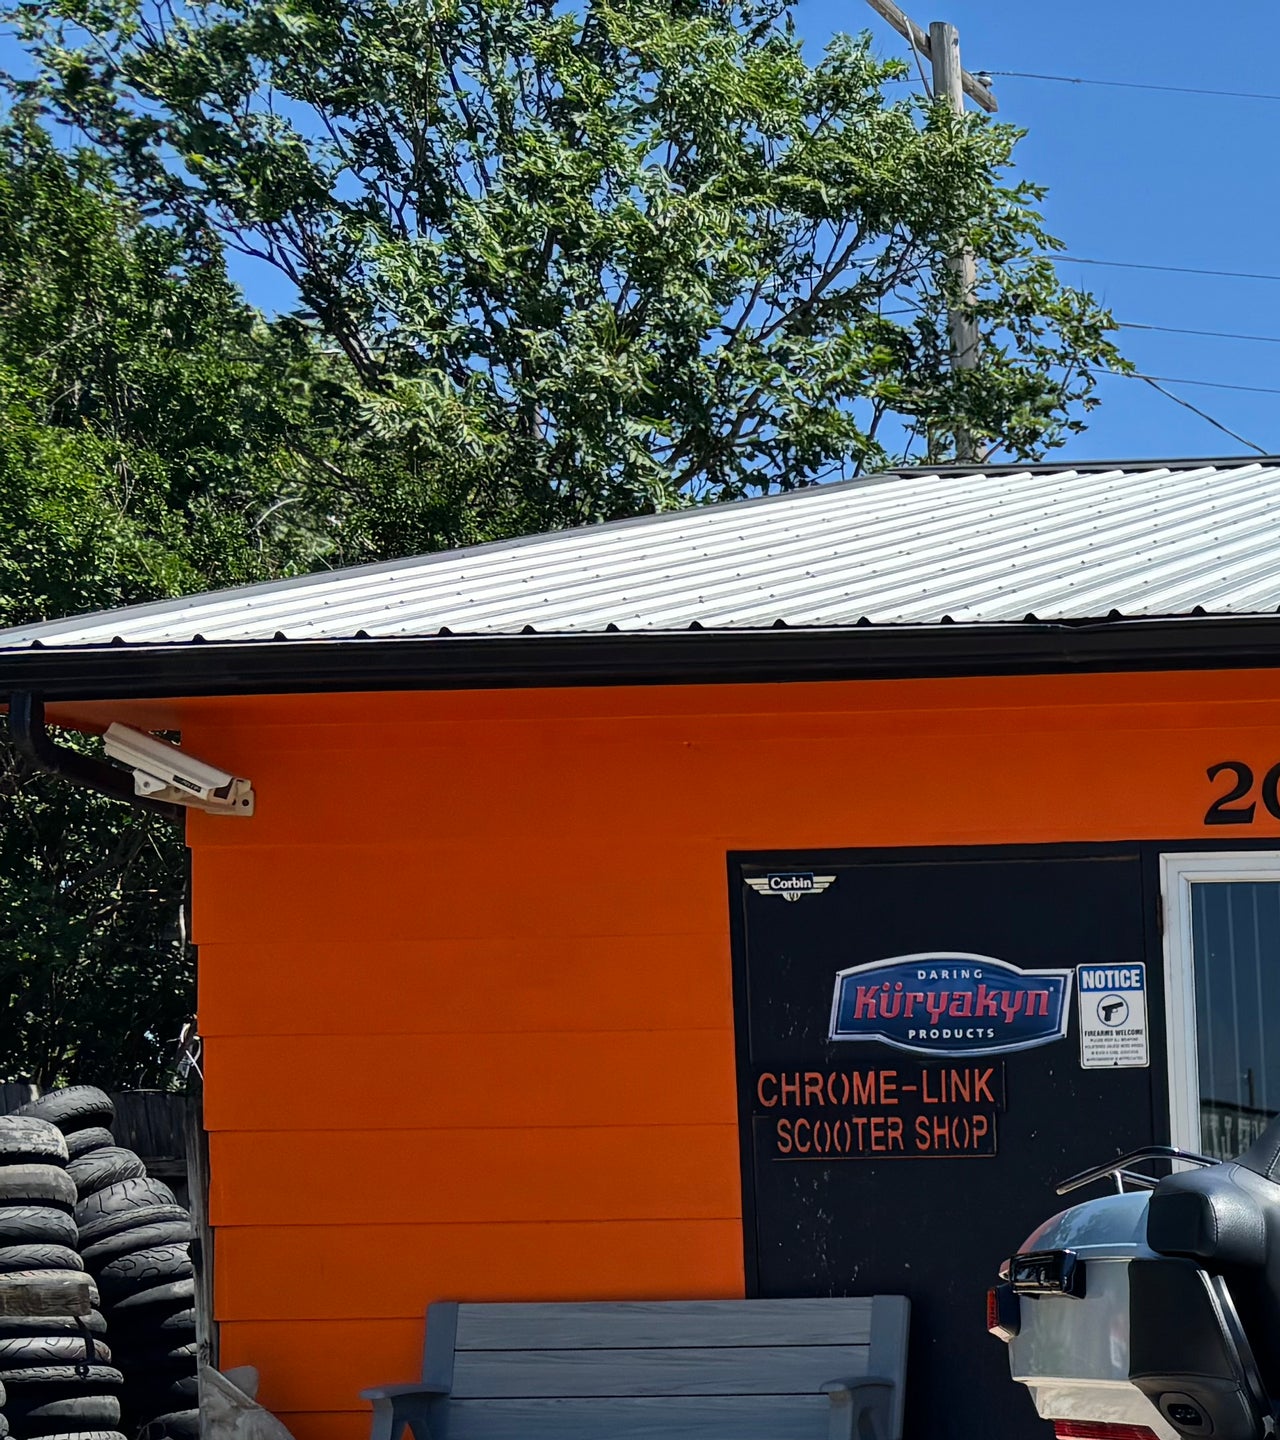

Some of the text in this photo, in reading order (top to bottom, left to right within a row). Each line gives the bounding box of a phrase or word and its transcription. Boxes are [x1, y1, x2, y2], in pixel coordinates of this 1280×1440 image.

[770, 876, 812, 889] Corbin
[918, 969, 983, 980] DARING
[1082, 968, 1141, 989] NOTICE
[908, 1028, 995, 1040] PRODUCTS
[757, 1068, 995, 1107] CHROME-LINK
[776, 1115, 988, 1153] SCOOTER SHOP
